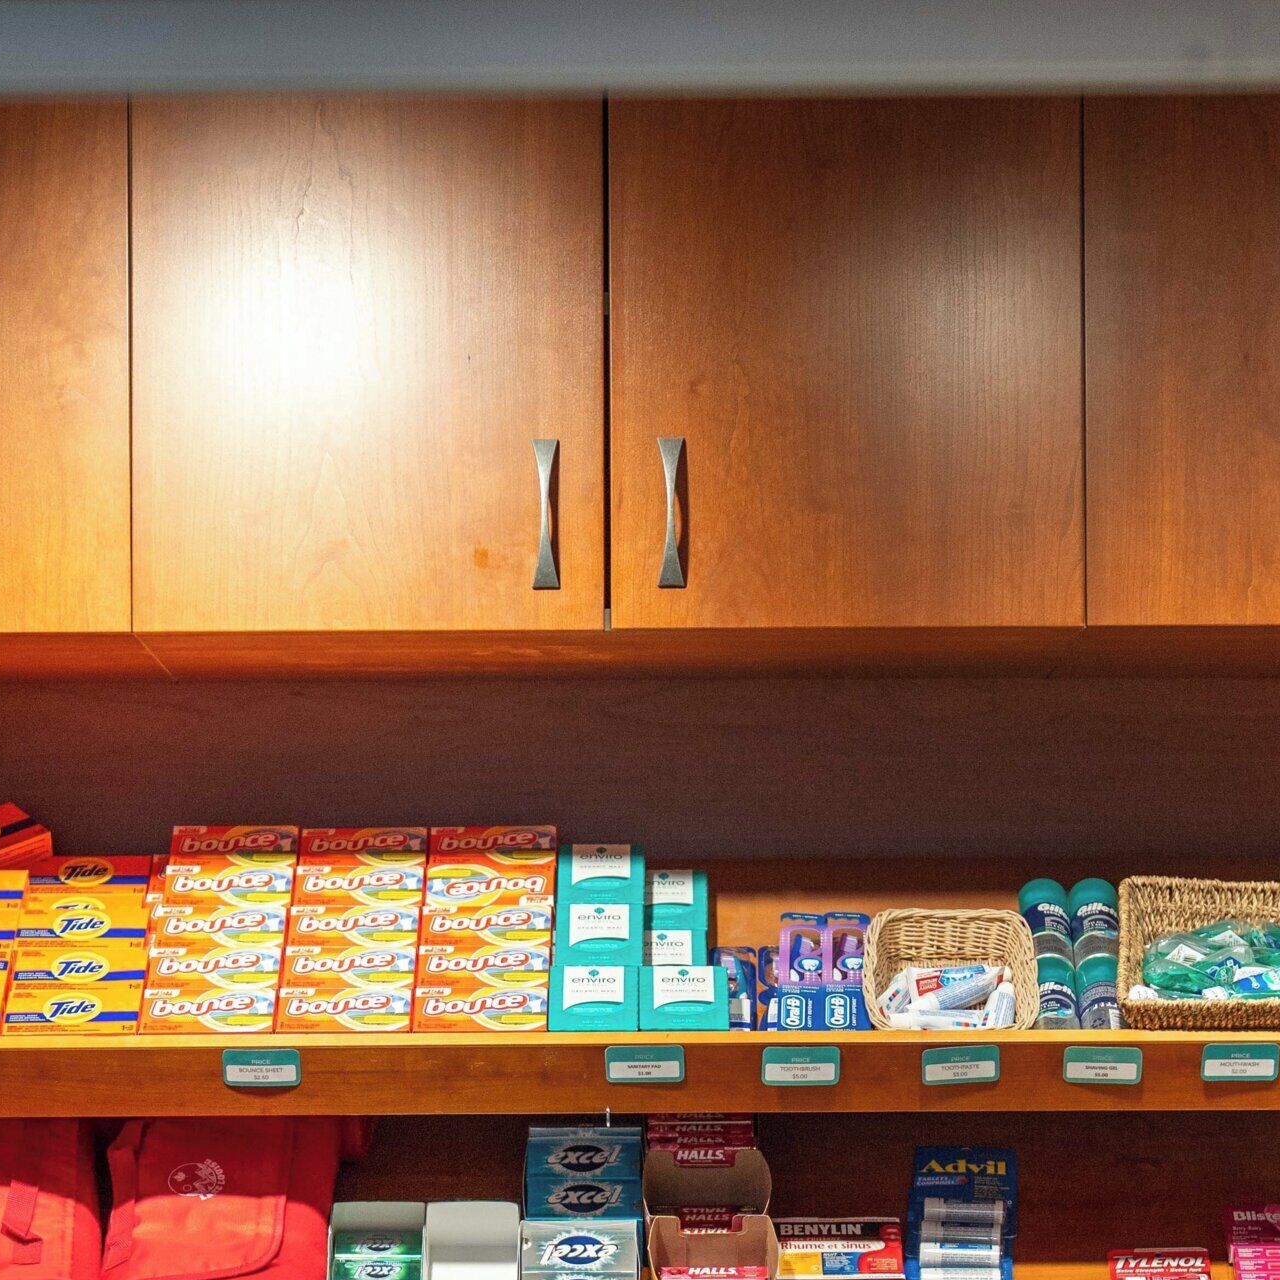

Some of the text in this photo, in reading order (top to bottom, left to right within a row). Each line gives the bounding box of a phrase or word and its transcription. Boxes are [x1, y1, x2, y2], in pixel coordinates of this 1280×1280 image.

[56, 916, 106, 935] Tide
[55, 958, 104, 977] Tide
[158, 953, 261, 974] bounce
[293, 952, 396, 973] bounce
[428, 952, 530, 973] bounce
[571, 976, 616, 984] enviro
[47, 999, 97, 1019] Tide
[150, 996, 255, 1017] bounce
[286, 995, 391, 1016] bounce
[423, 994, 527, 1016] bounce
[547, 1145, 622, 1165] excel
[677, 1150, 725, 1161] HALLS
[920, 1159, 1007, 1175] Advil
[548, 1185, 623, 1205] excel
[780, 1224, 862, 1235] BENYLIN
[781, 1242, 824, 1250] Rhume
[688, 1267, 738, 1275] HALLS
[1113, 1256, 1206, 1269] TYLENOL
